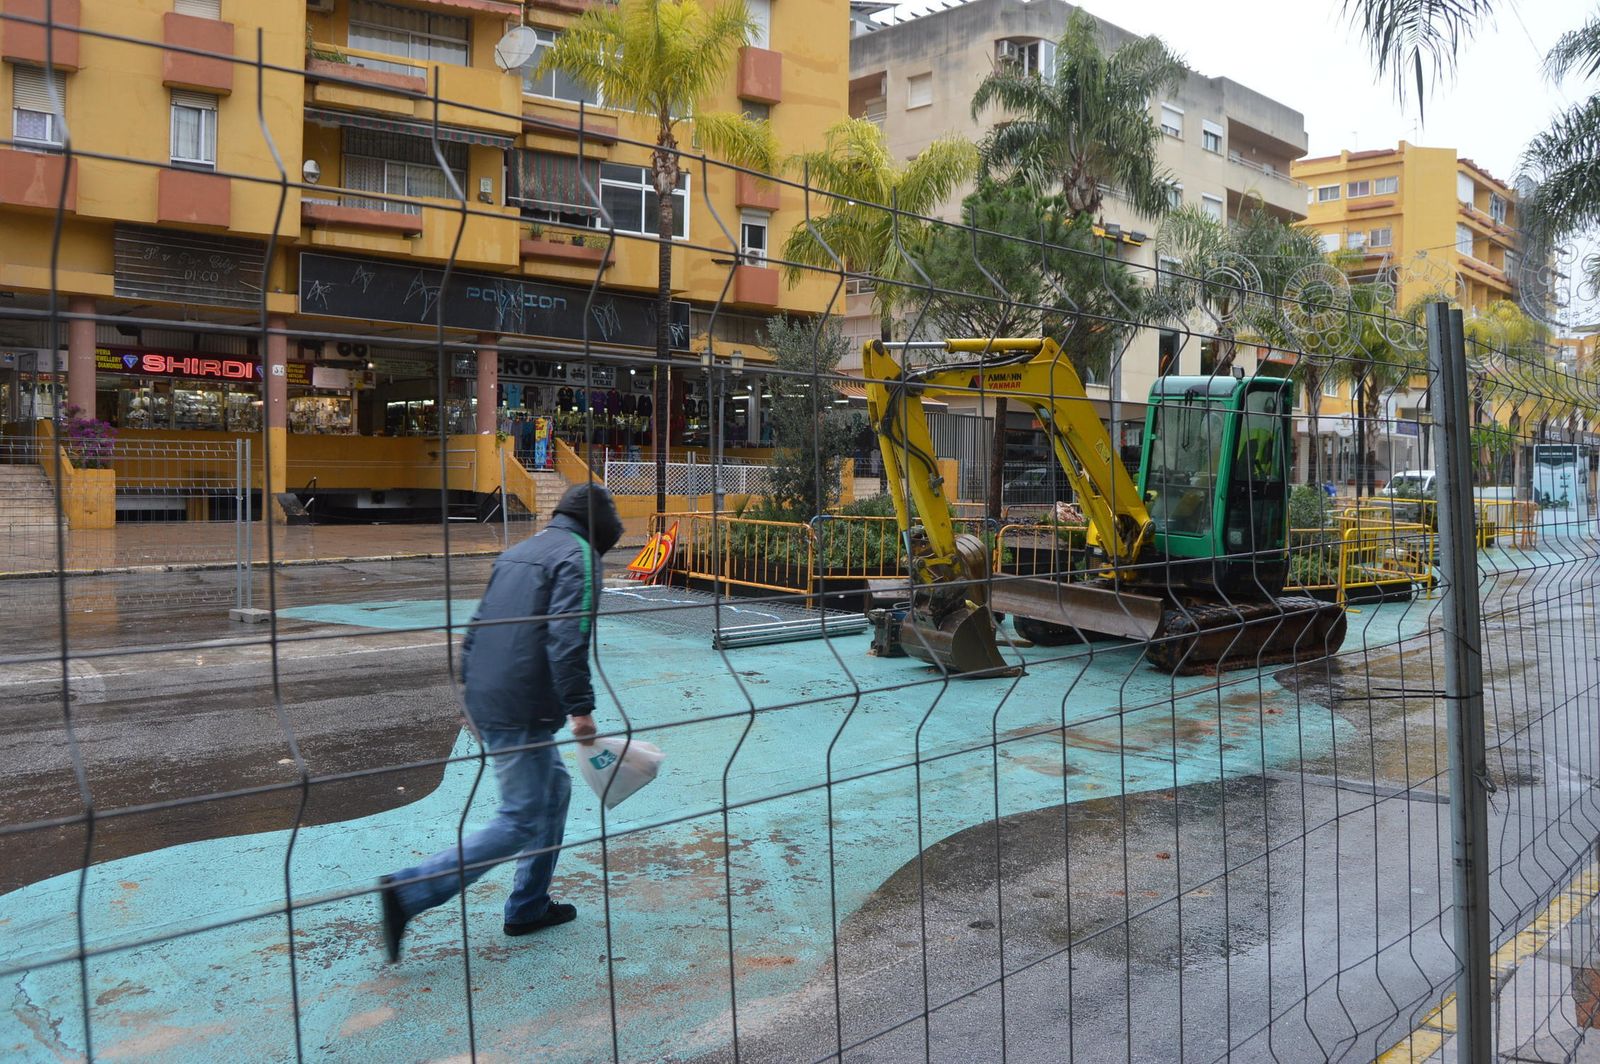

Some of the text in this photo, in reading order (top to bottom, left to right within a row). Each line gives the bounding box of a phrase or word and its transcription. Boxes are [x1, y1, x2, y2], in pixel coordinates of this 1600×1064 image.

[184, 269, 219, 282] DICO
[142, 354, 253, 379] SHIRDI
[988, 373, 1022, 381] AMMANN
[988, 381, 1022, 389] YANMAR
